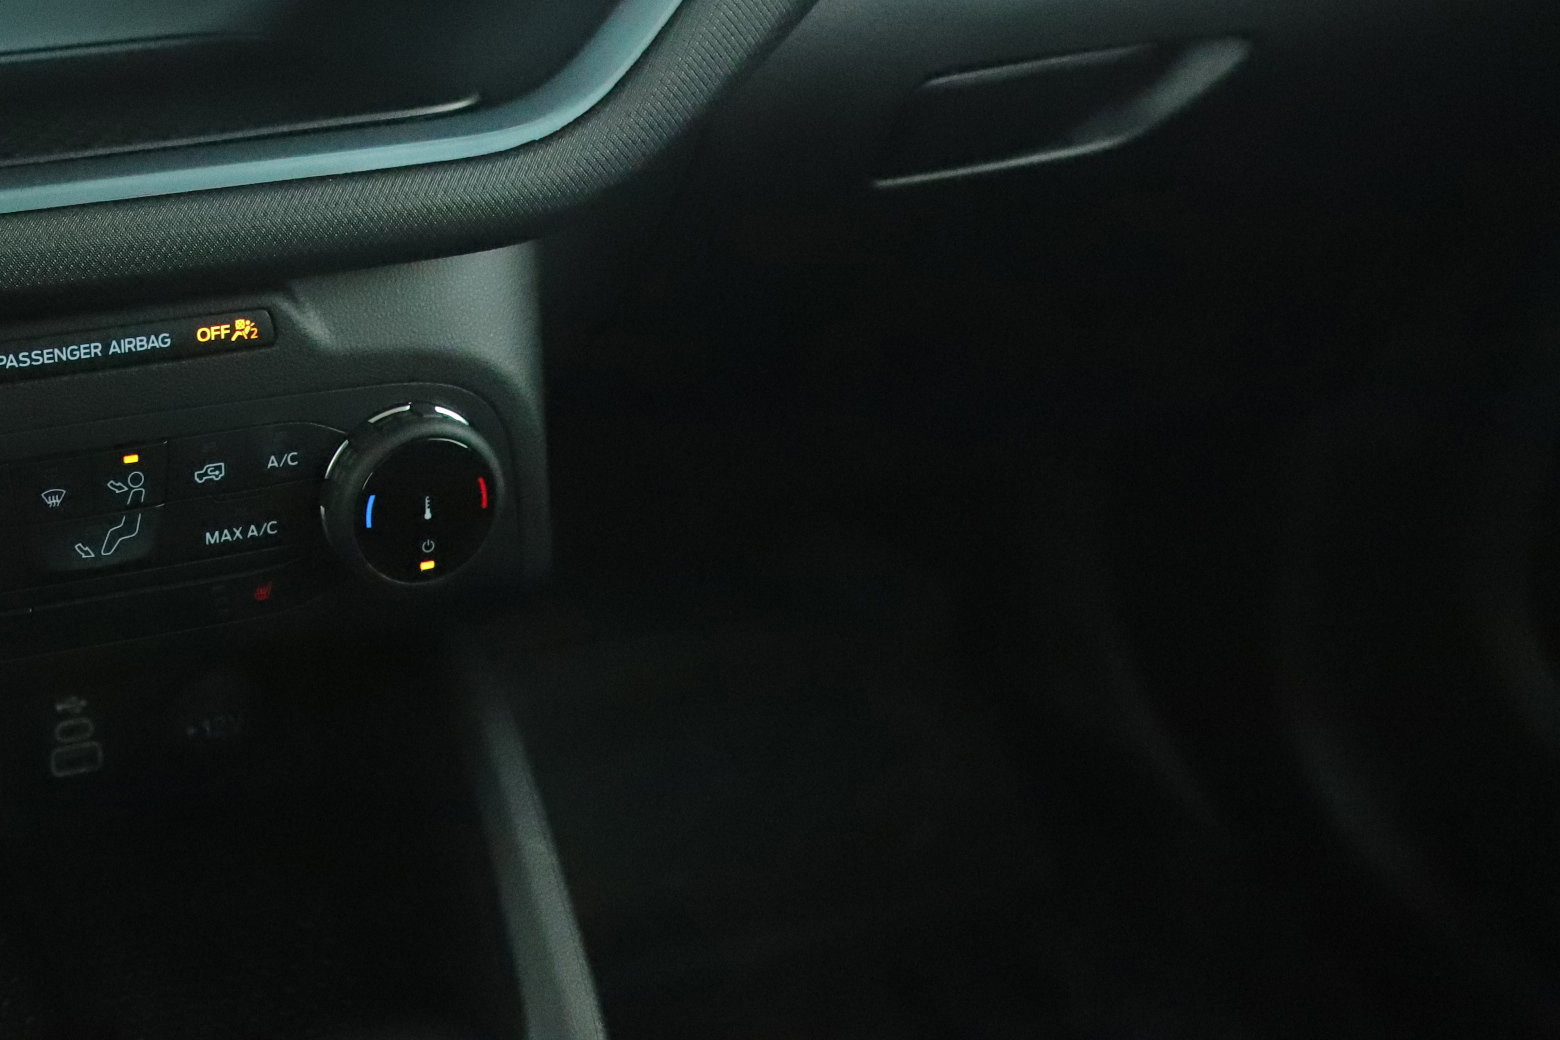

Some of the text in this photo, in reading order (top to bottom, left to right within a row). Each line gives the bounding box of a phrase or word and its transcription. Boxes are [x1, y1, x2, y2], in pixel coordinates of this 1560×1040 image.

[108, 332, 172, 356] AIRBAG
[196, 324, 231, 343] OFF
[267, 451, 299, 469] A/C
[205, 520, 278, 545] MAX A/C
